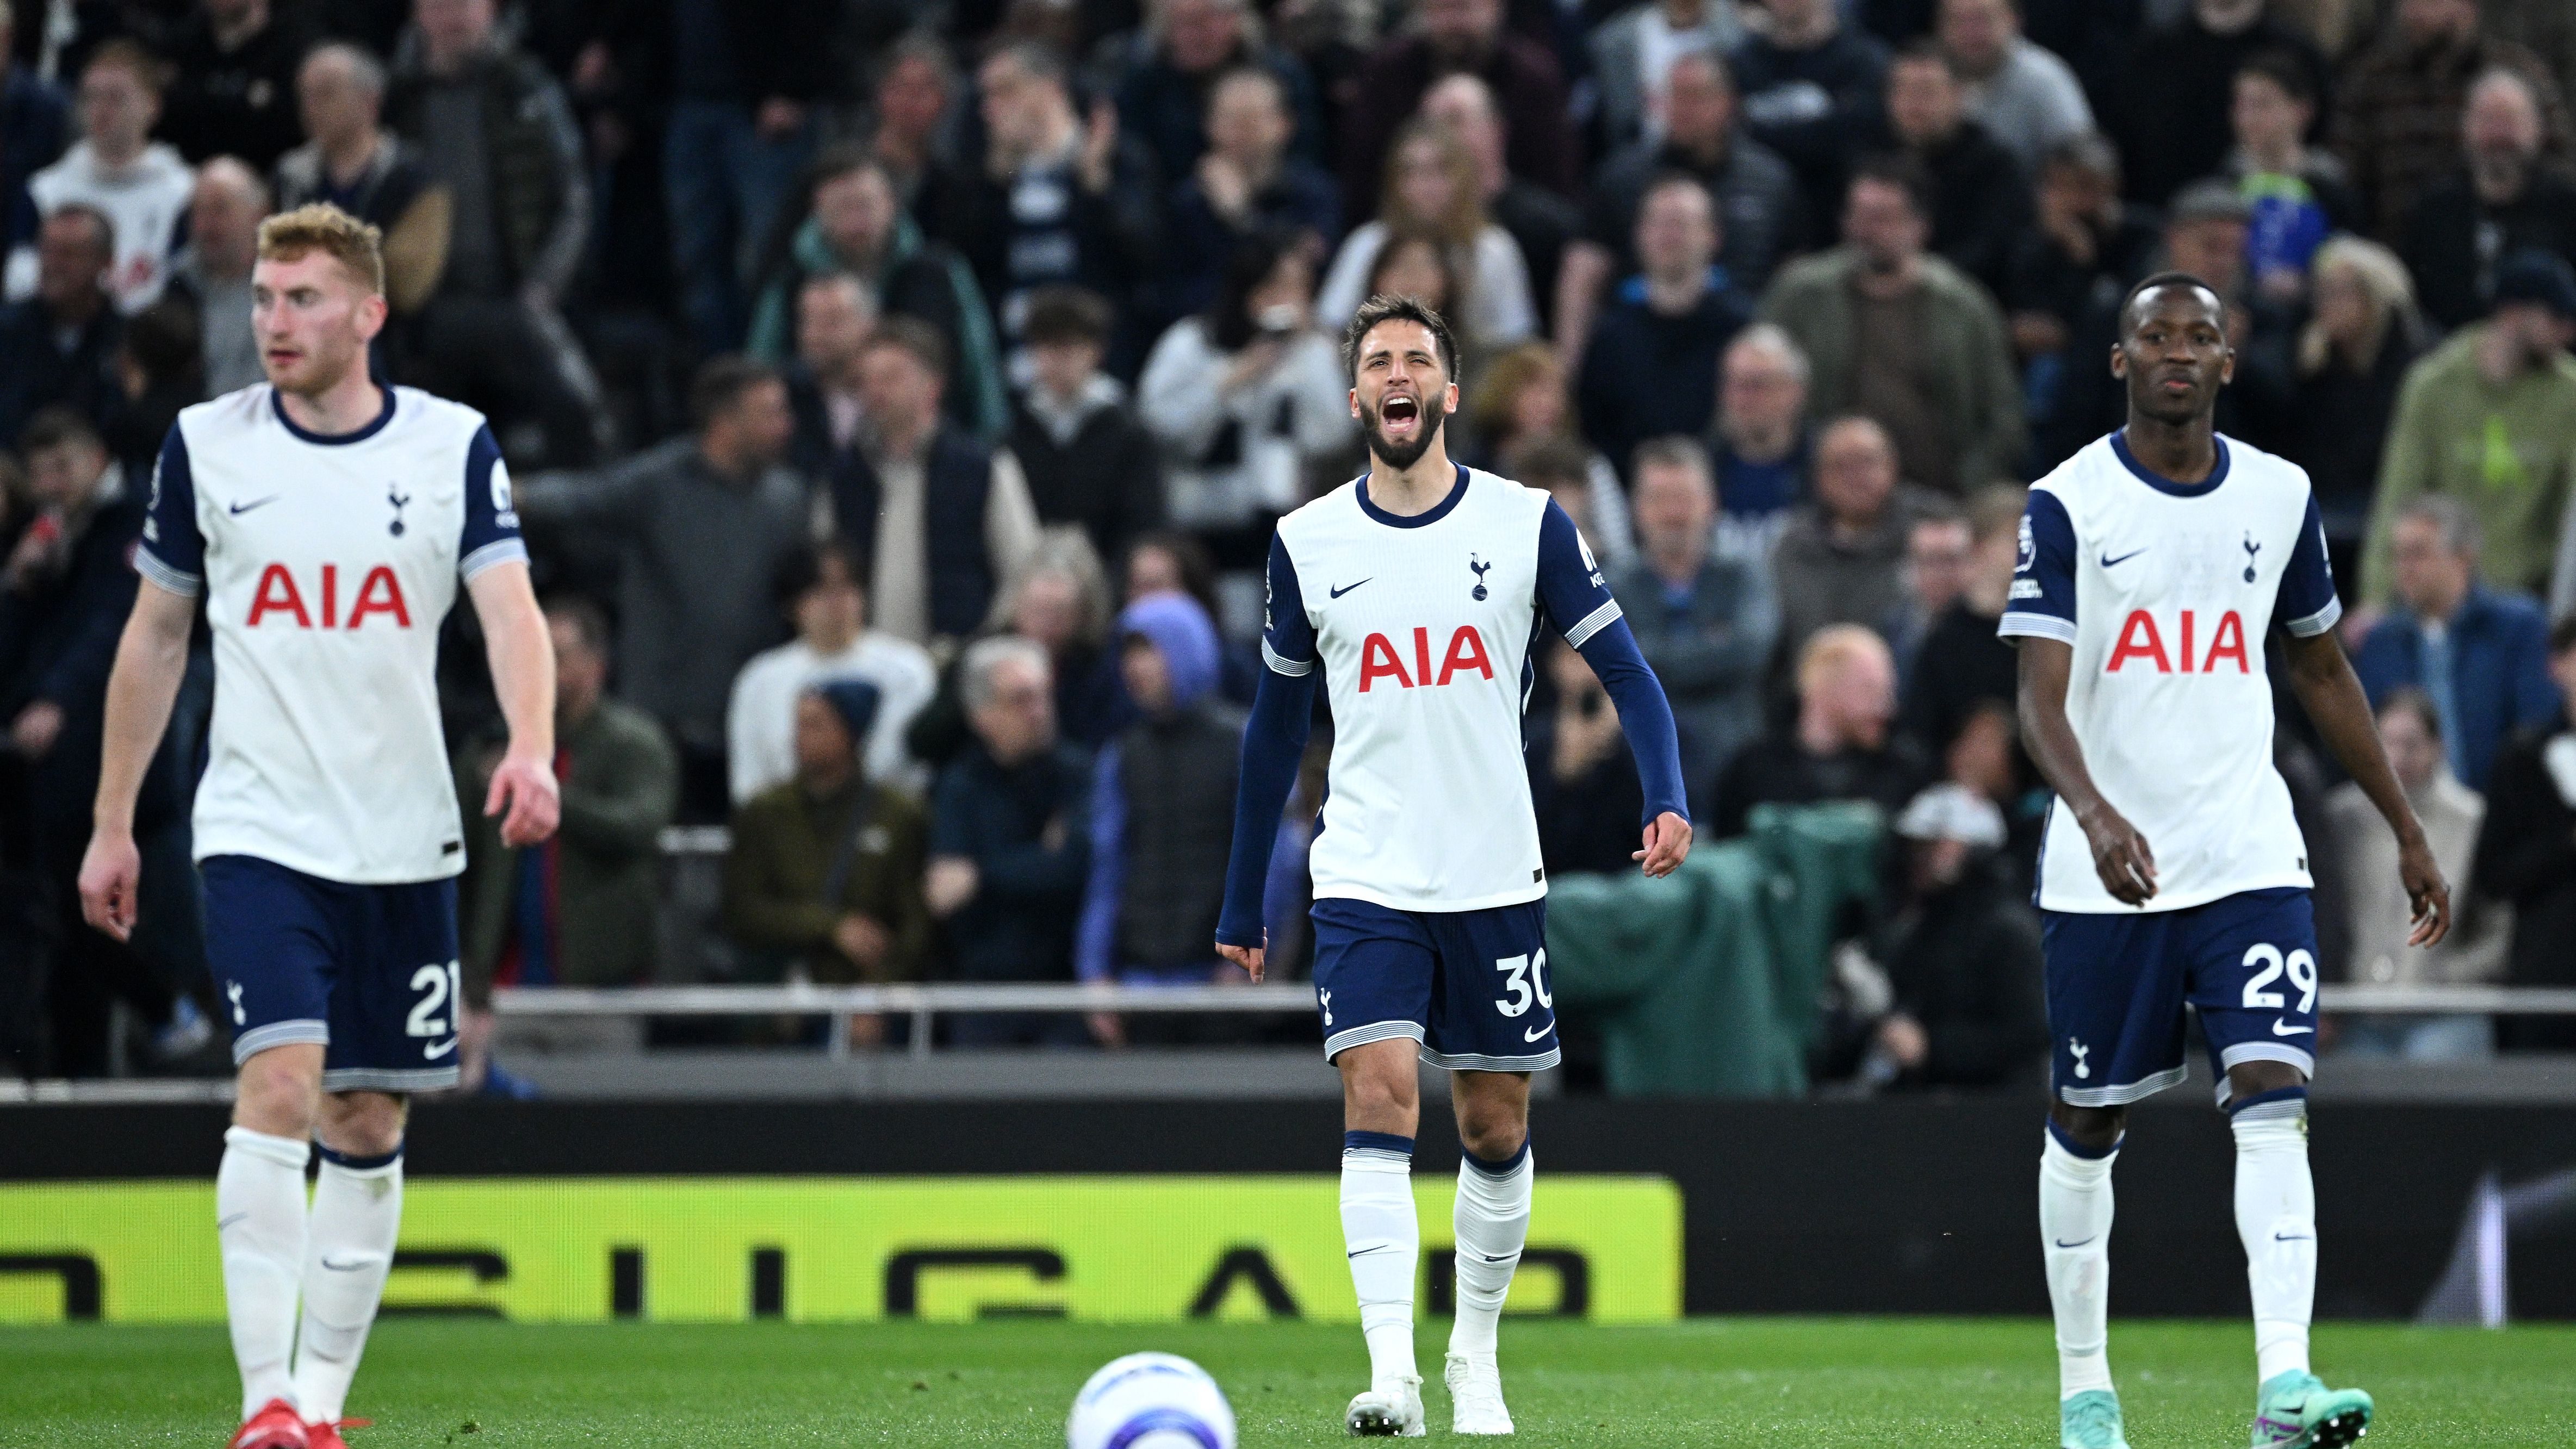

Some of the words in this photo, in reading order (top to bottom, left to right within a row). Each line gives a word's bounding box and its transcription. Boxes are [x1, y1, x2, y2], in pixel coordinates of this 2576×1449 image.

[247, 563, 411, 629] AIA
[1359, 625, 1493, 693] AIA
[2106, 609, 2250, 674] AIA
[406, 959, 461, 1037] 21
[1495, 947, 1552, 1017] 30
[2242, 942, 2317, 1015] 29
